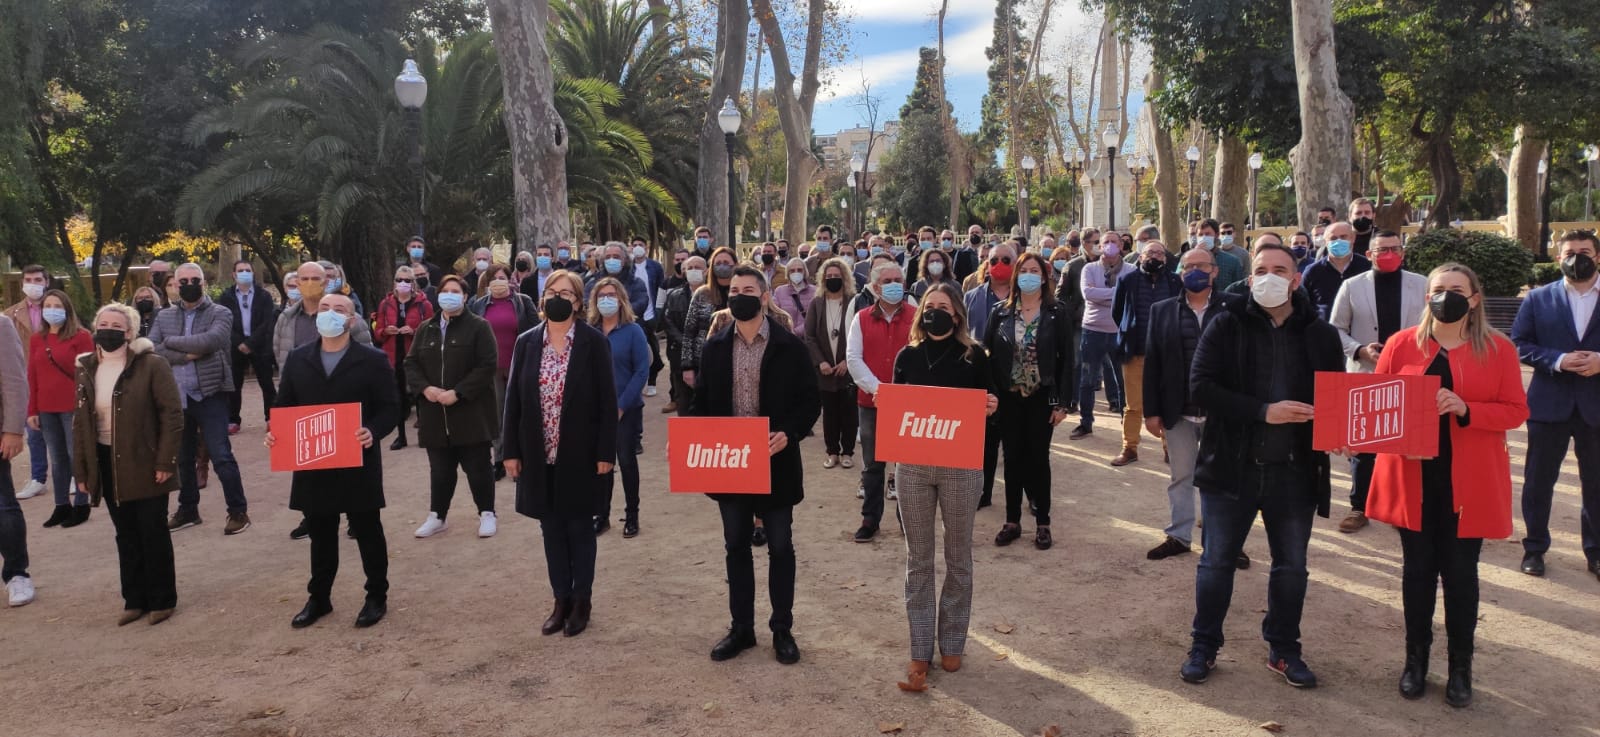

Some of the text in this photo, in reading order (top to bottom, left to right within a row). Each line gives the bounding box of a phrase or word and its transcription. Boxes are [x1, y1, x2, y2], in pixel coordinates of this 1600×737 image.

[1353, 384, 1400, 415] EL FUTUR
[299, 413, 333, 440] EL FUTUR
[898, 411, 961, 440] Futur
[1352, 411, 1399, 441] ÉS ARA
[315, 433, 333, 456] ARA
[686, 442, 751, 468] Unitat
